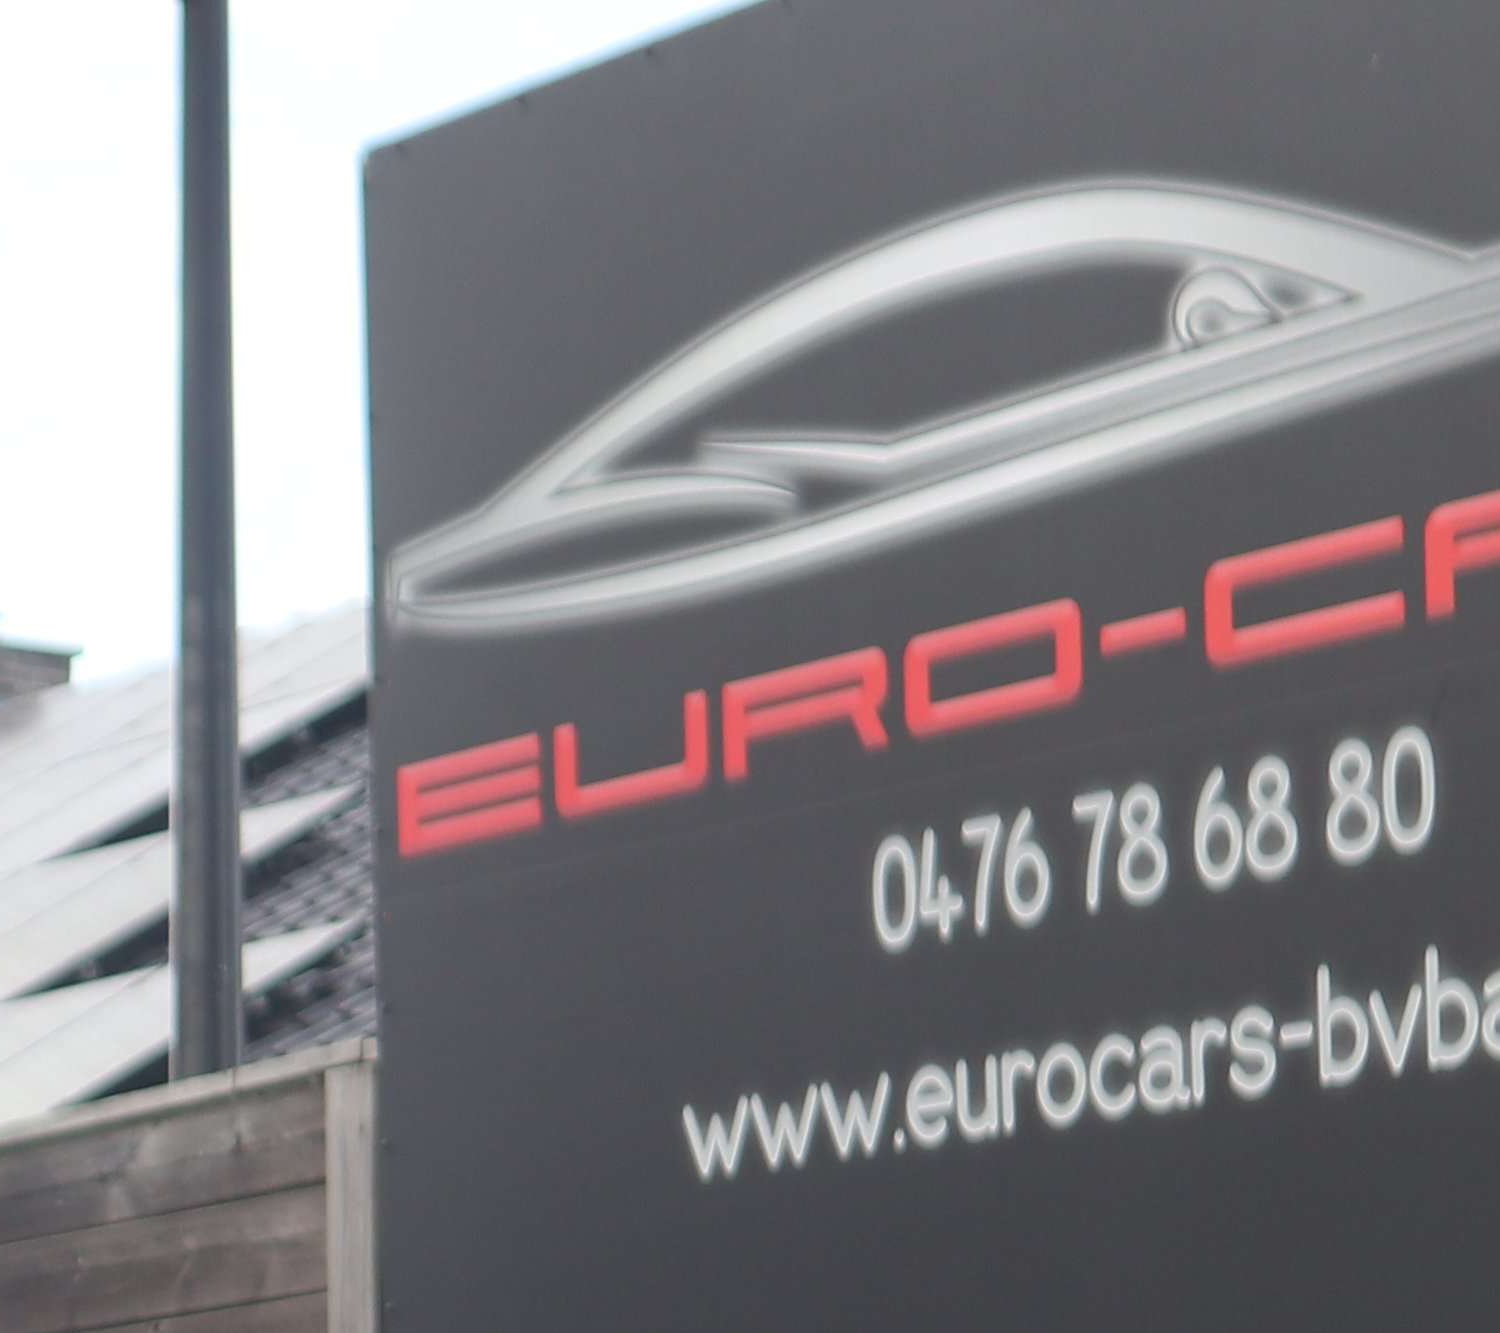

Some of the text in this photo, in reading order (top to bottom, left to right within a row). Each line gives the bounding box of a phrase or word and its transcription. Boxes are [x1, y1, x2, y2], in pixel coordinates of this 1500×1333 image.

[870, 725, 1436, 953] 0476 78 68 80
